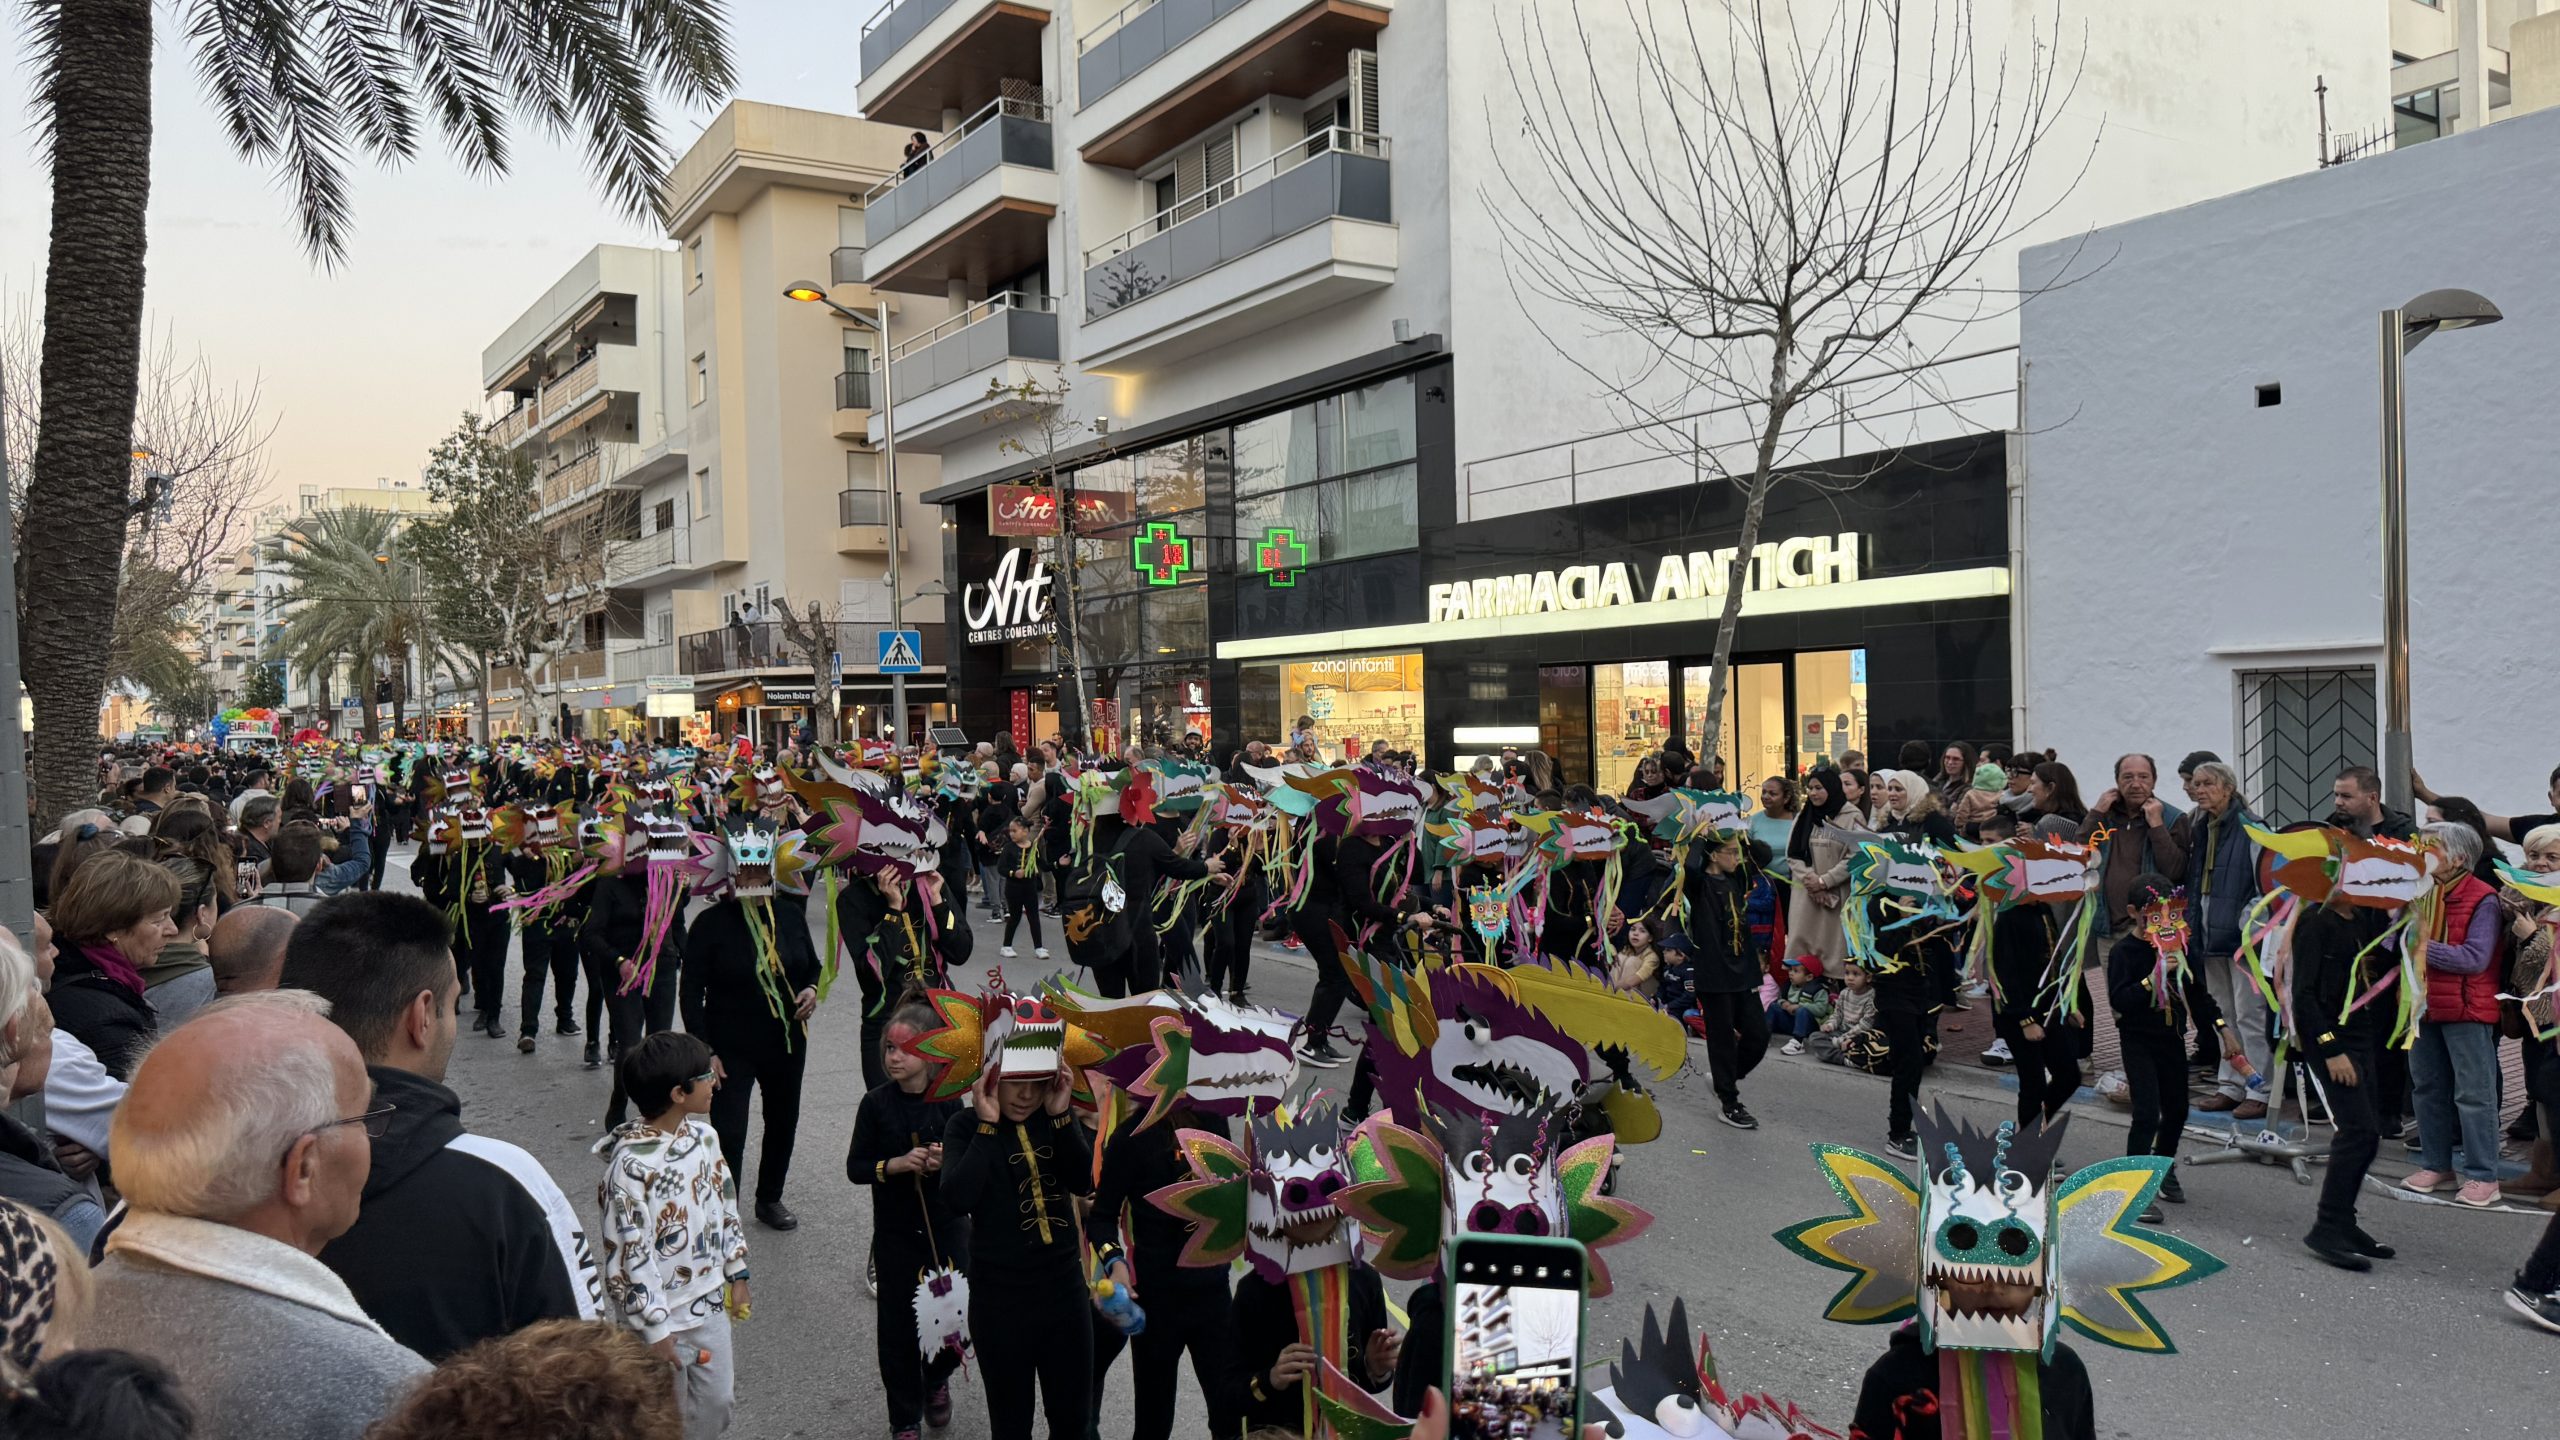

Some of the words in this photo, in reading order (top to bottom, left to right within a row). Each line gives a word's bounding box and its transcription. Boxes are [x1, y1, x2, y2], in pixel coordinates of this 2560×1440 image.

[998, 496, 1054, 519] Art
[1163, 544, 1182, 564] 18
[964, 547, 1053, 630] Art
[1429, 561, 1634, 623] FARMACIA
[1651, 532, 1858, 602] ANTICH
[968, 629, 1002, 643] CENTRES
[1005, 621, 1057, 639] COMERCIALS
[1311, 660, 1346, 673] zona
[1349, 657, 1395, 673] infantil
[767, 692, 791, 700] Nolam
